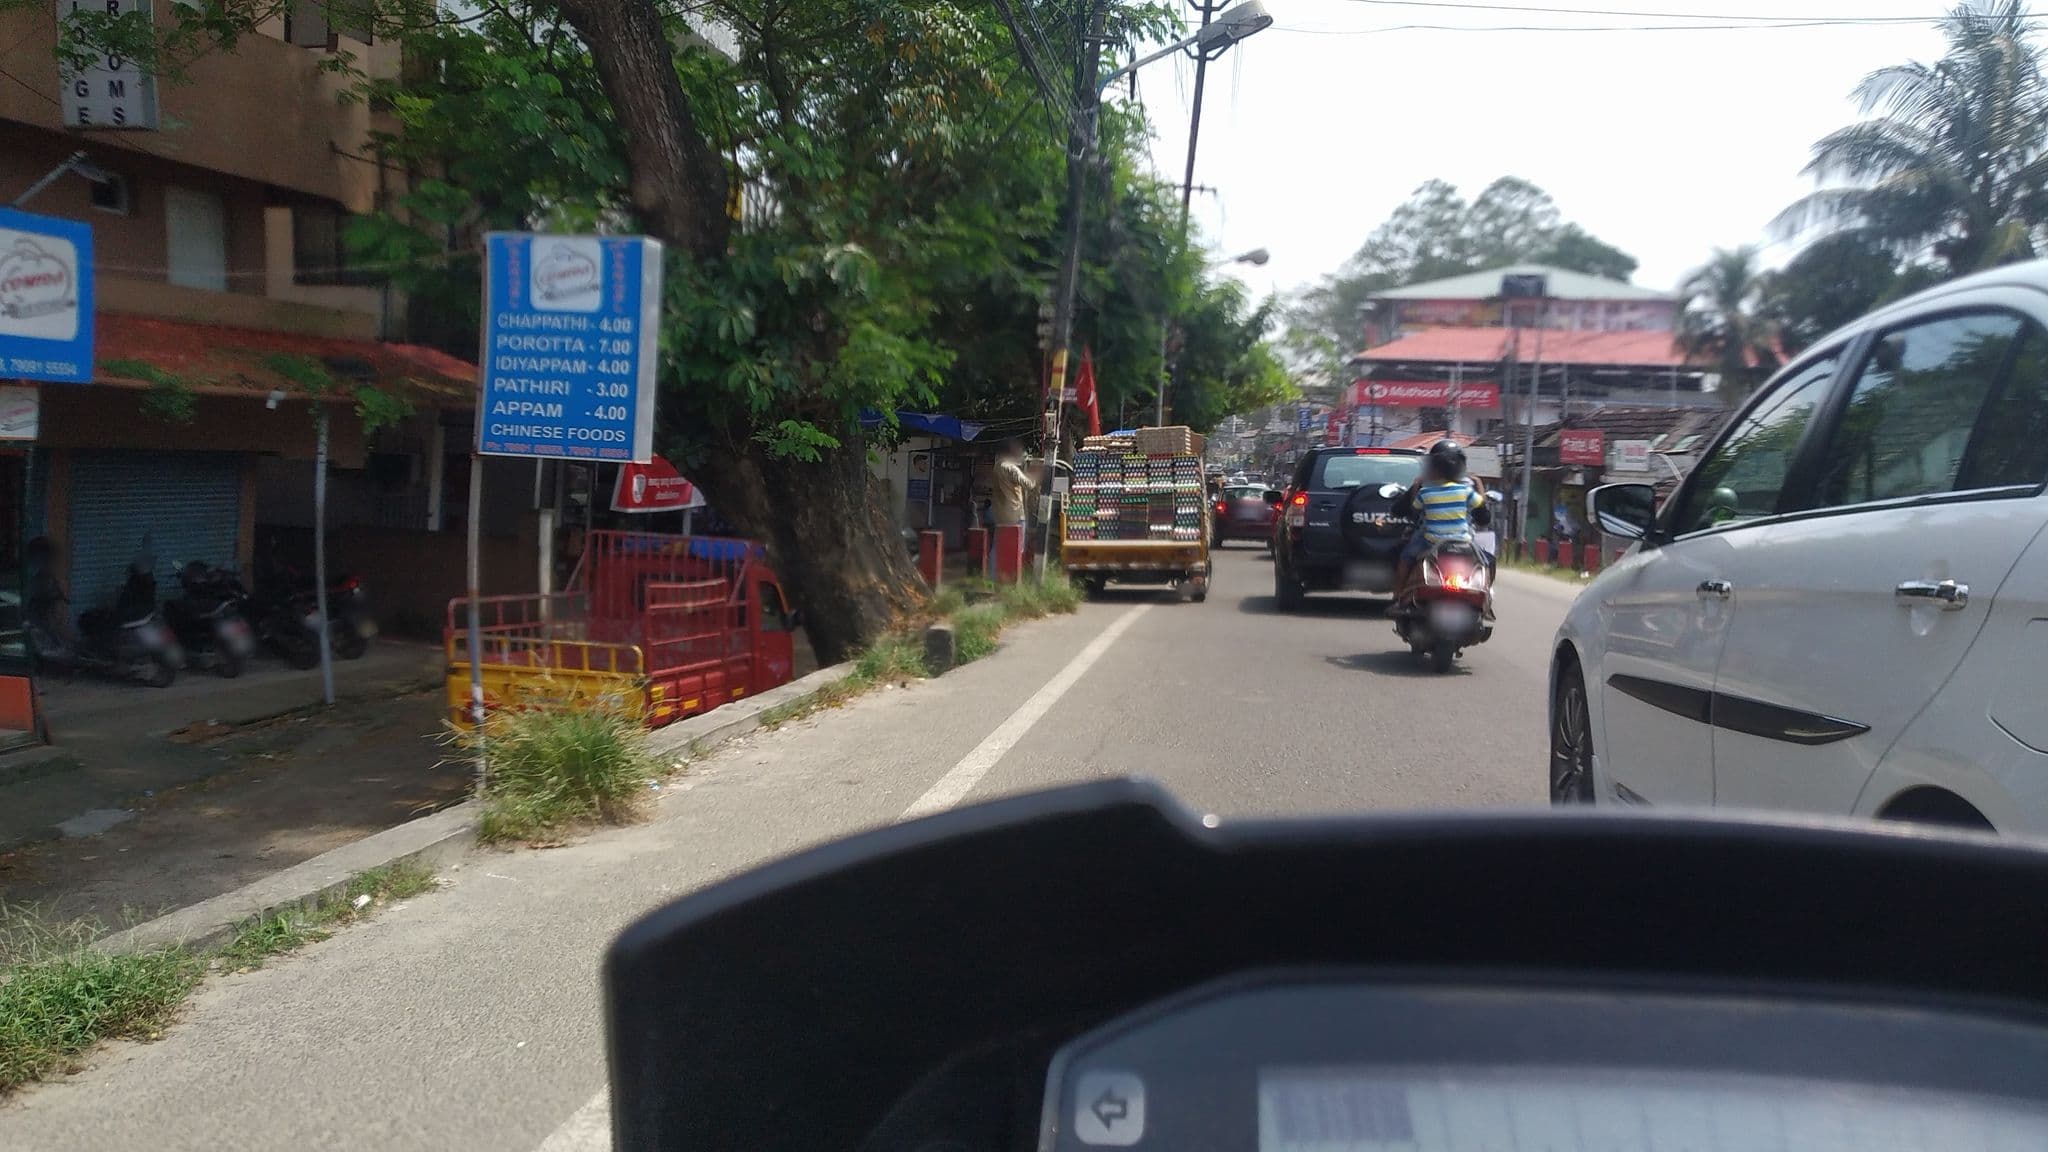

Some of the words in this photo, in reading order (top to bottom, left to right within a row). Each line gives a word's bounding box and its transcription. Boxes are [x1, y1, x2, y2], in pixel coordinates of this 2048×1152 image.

[106, 0, 125, 126] ROMS
[497, 313, 587, 330] CHAPPATHI
[599, 316, 632, 333] 4.00
[496, 335, 584, 352] POROTTA
[599, 339, 630, 355] 7.00
[495, 356, 586, 374] IDIYAPPAM
[597, 360, 630, 374] 4.00
[494, 378, 570, 395] PATHIRI
[596, 382, 628, 397] 3.00
[492, 401, 563, 417] APPAM
[594, 405, 626, 420] 4.00
[490, 423, 563, 439] CHINESE
[567, 427, 626, 442] FOODS
